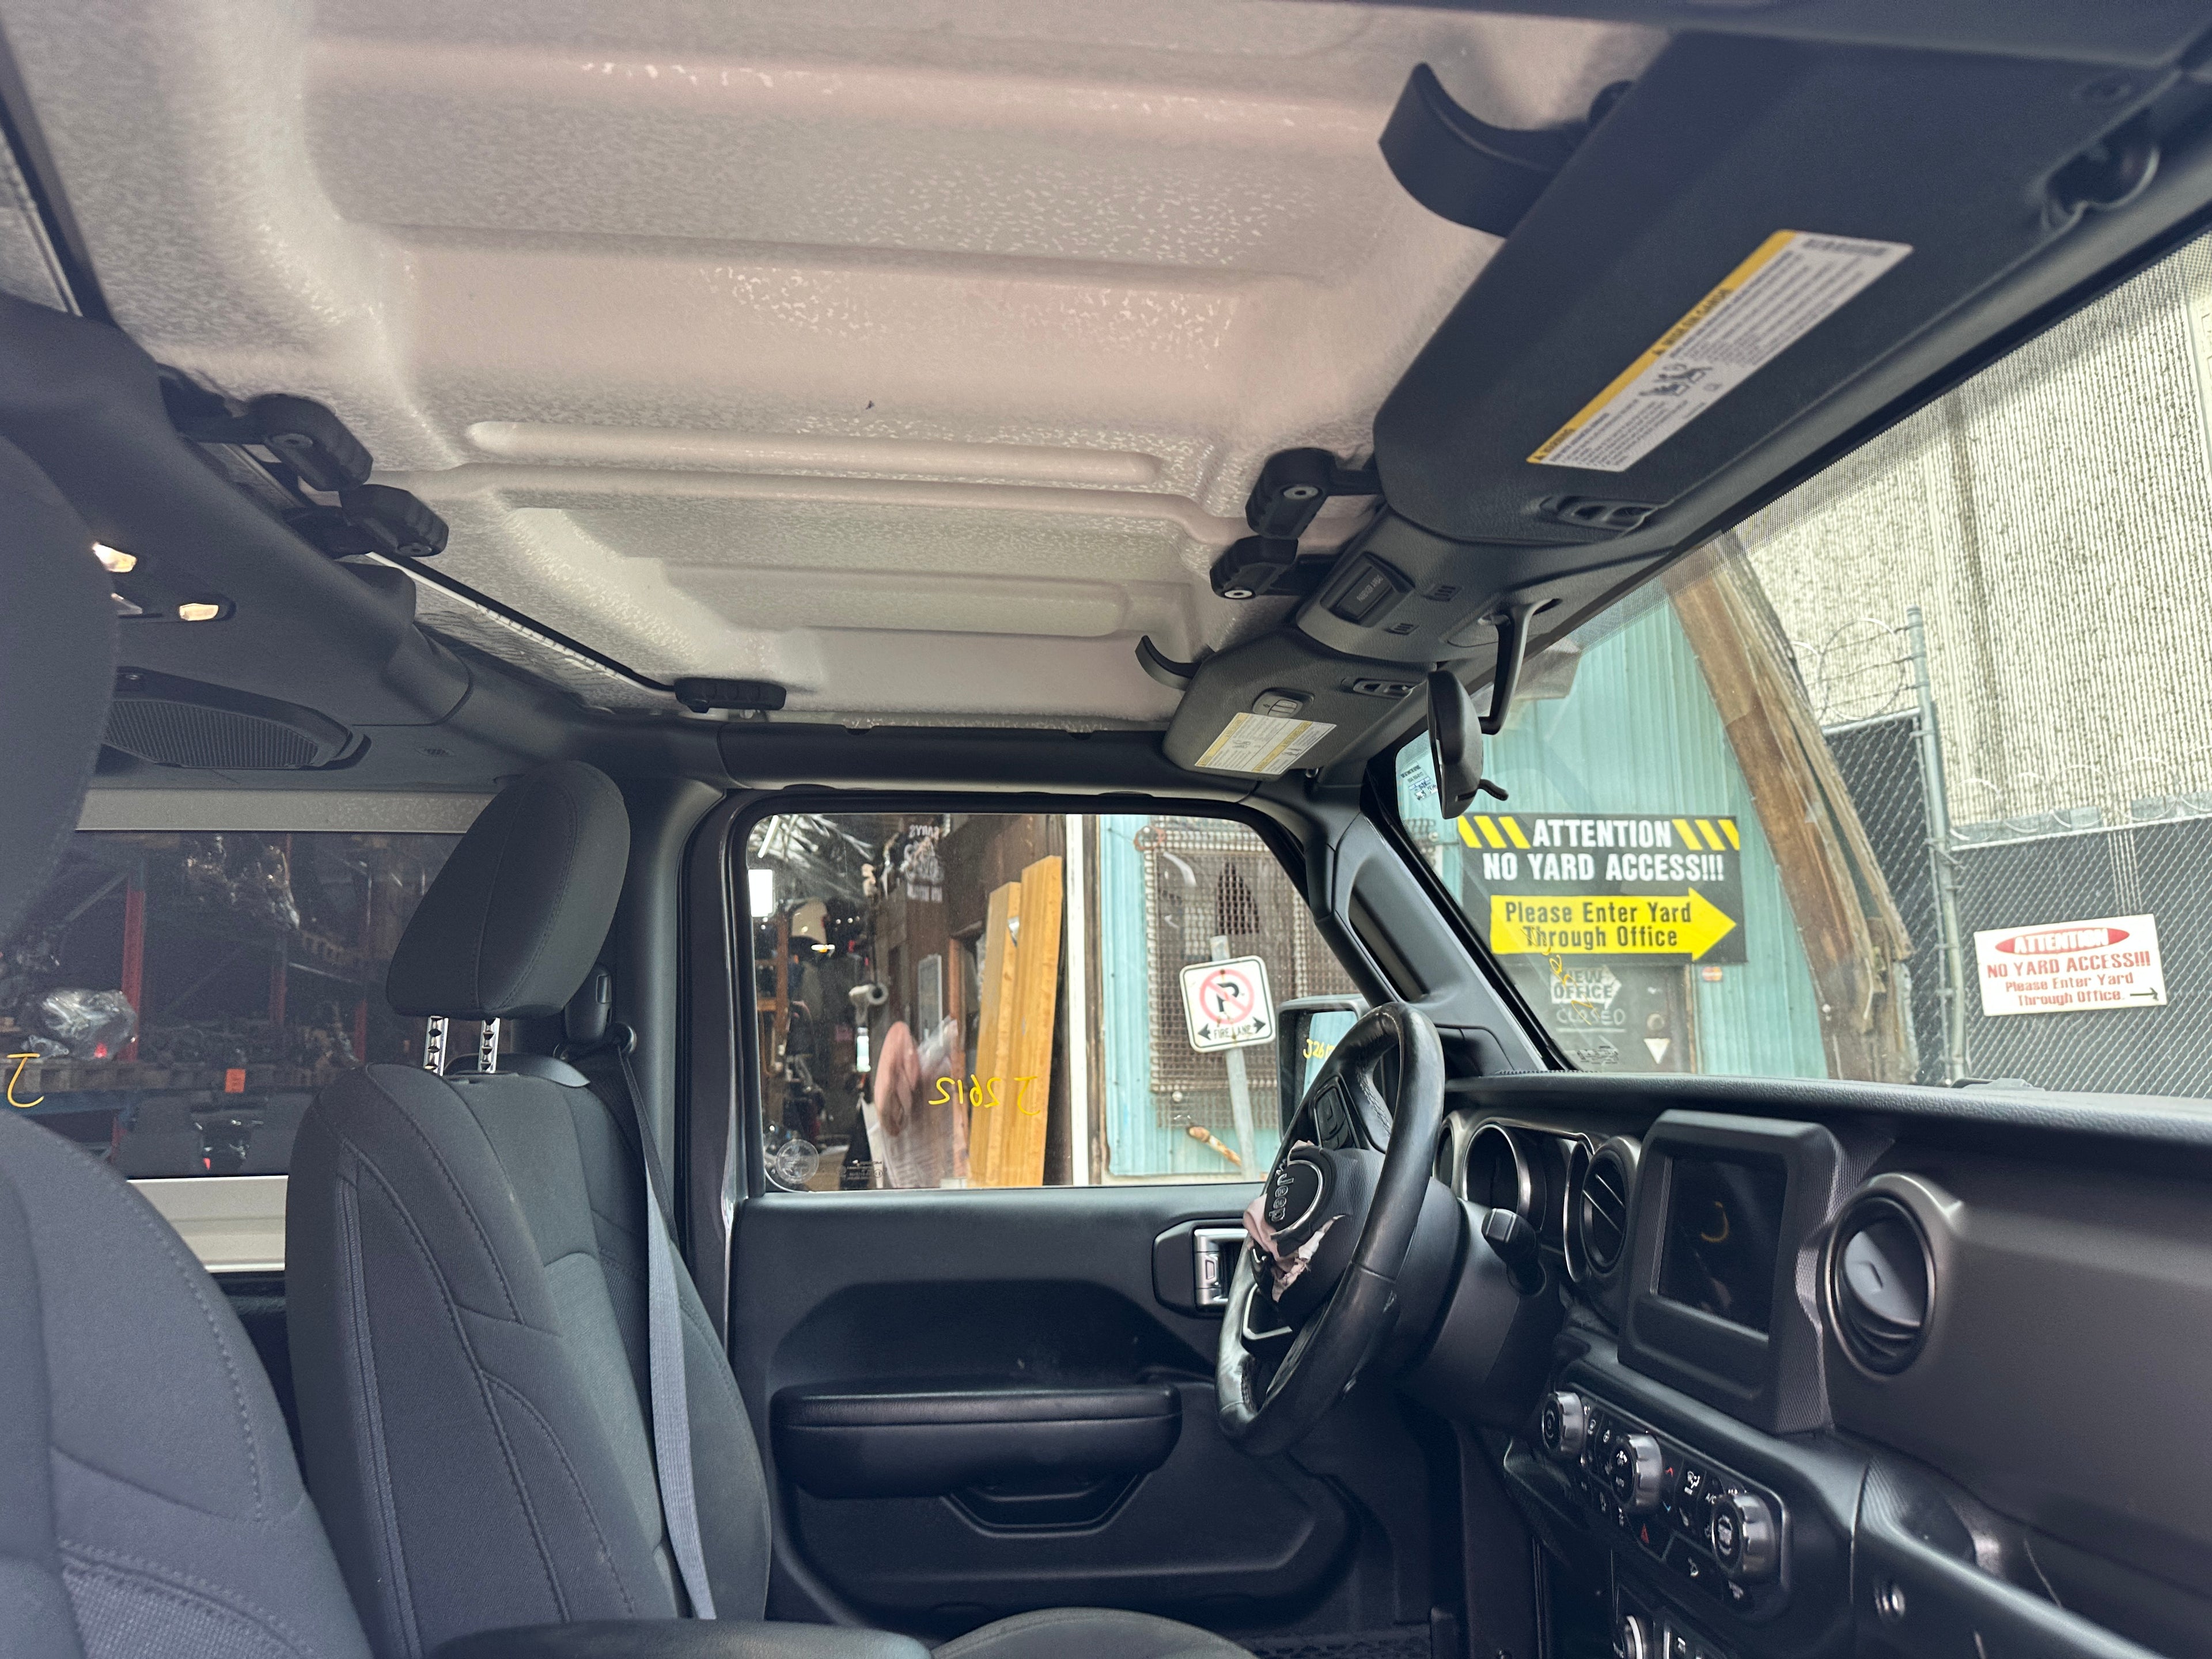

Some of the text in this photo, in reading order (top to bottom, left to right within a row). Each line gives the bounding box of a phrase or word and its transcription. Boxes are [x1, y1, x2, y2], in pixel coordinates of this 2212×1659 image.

[1532, 819, 1671, 848] ATTENTION
[1483, 853, 1724, 881] NO YARD ACCESS!!!
[1505, 902, 1691, 923] Please Enter Yard
[1524, 926, 1677, 950] Through Office
[2014, 928, 2109, 954] ATTENTION
[1987, 950, 2151, 978] NO YARD ACCESS!!!
[1553, 984, 1613, 999] OFFICE
[2005, 972, 2134, 993] Please Enter Yard
[2017, 992, 2073, 1007] Through
[1213, 1027, 1230, 1039] FIRE
[1268, 1173, 1294, 1222] Jeep
